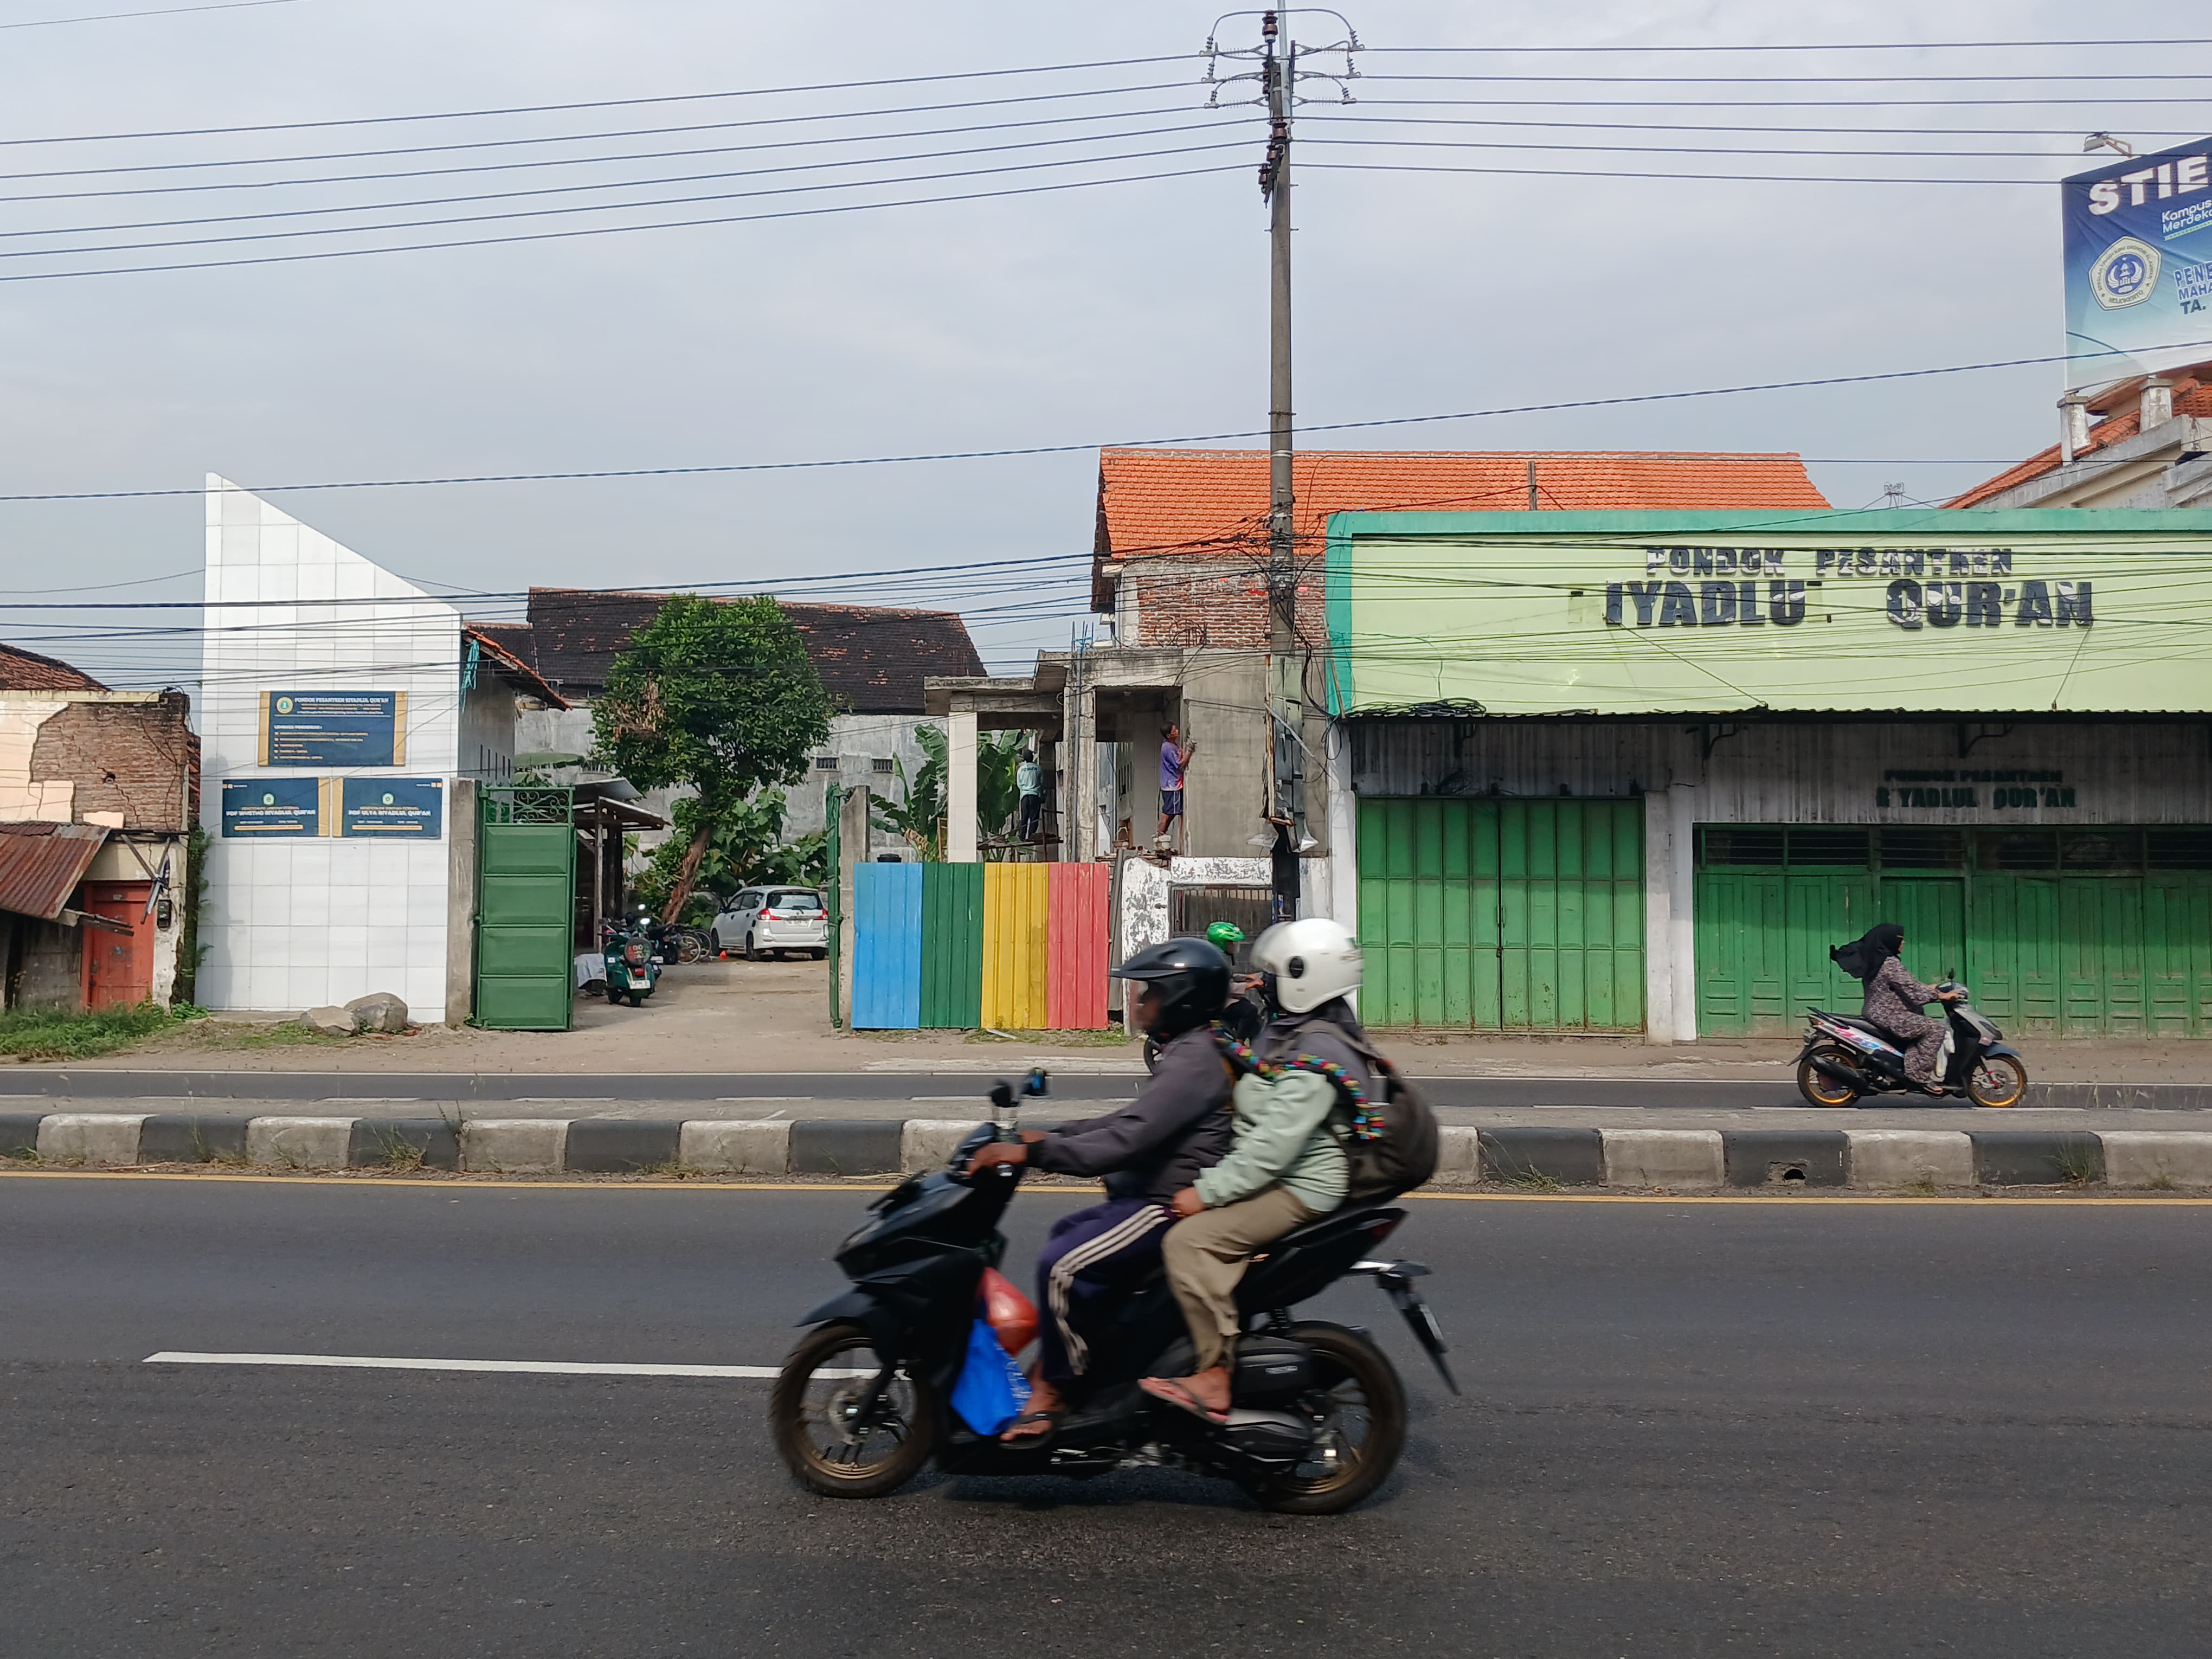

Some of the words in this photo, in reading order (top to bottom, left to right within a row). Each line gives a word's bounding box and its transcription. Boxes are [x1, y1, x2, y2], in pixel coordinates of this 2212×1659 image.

[2088, 153, 2209, 216] STIE
[2162, 199, 2212, 223] Kampus
[2180, 299, 2206, 314] TA.
[1647, 548, 1785, 576] PONDOK
[1816, 548, 2011, 577] PESANTREN
[1887, 579, 2093, 631] QUR'AN
